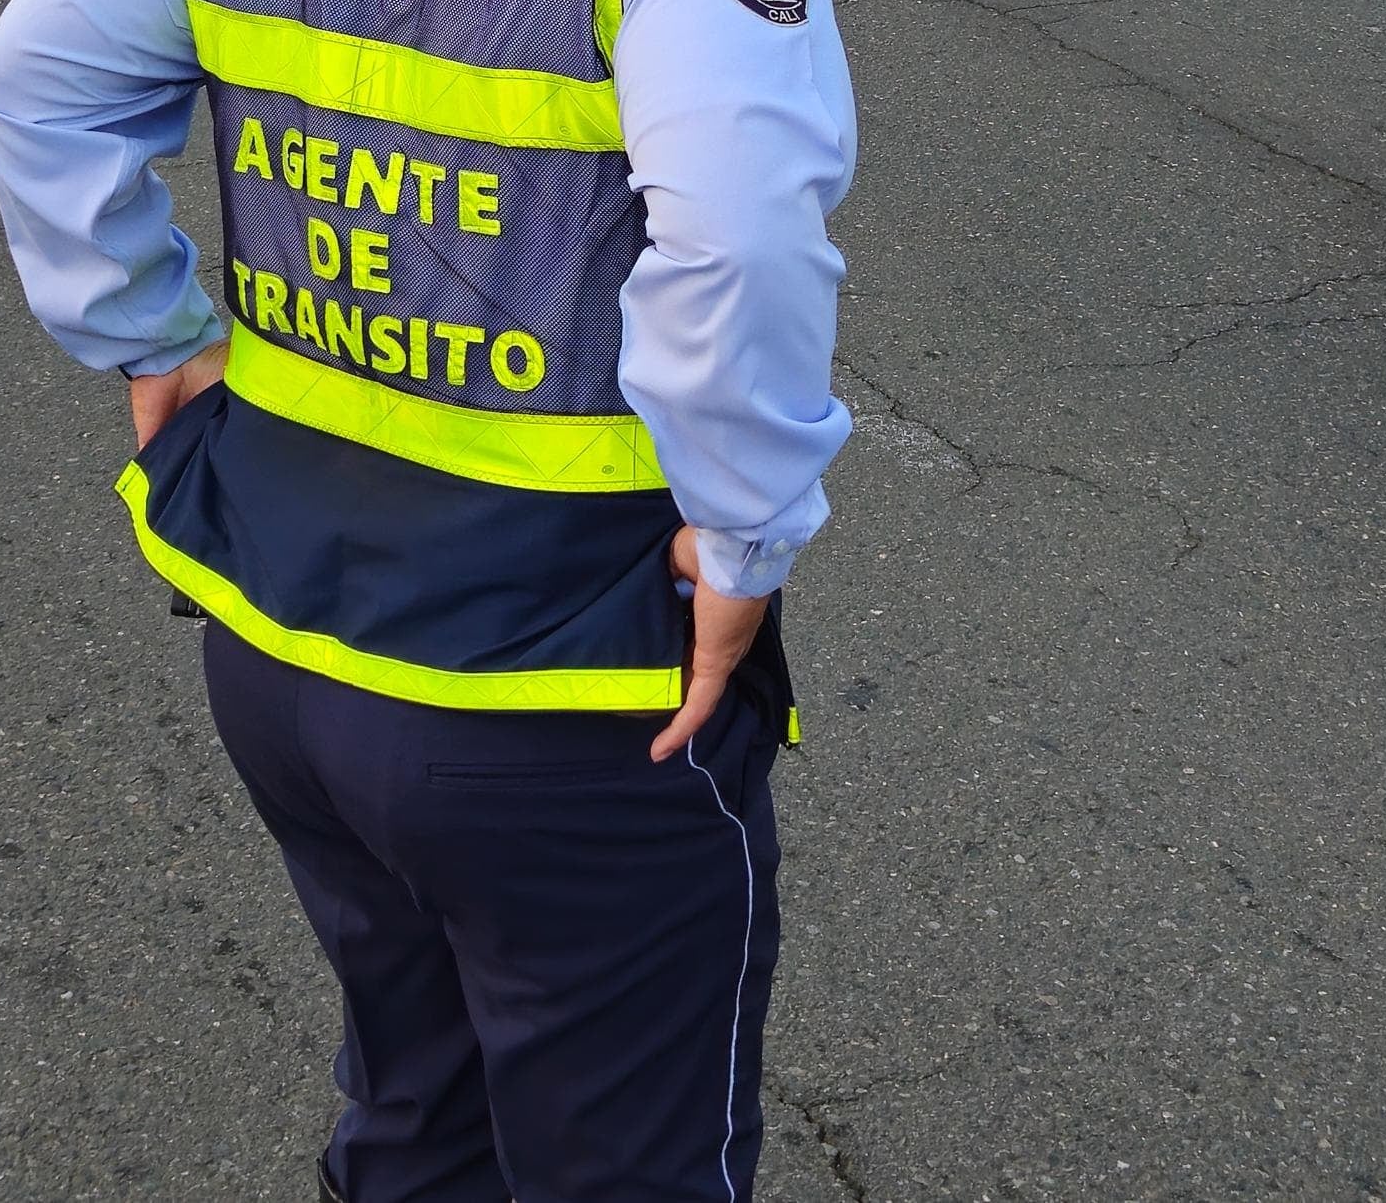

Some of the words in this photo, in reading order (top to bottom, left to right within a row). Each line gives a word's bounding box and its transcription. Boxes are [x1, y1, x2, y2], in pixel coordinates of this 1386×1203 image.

[768, 9, 801, 23] CALI
[233, 117, 501, 236] AGENTE
[308, 218, 393, 295] DE
[232, 259, 547, 391] TRANSITO
